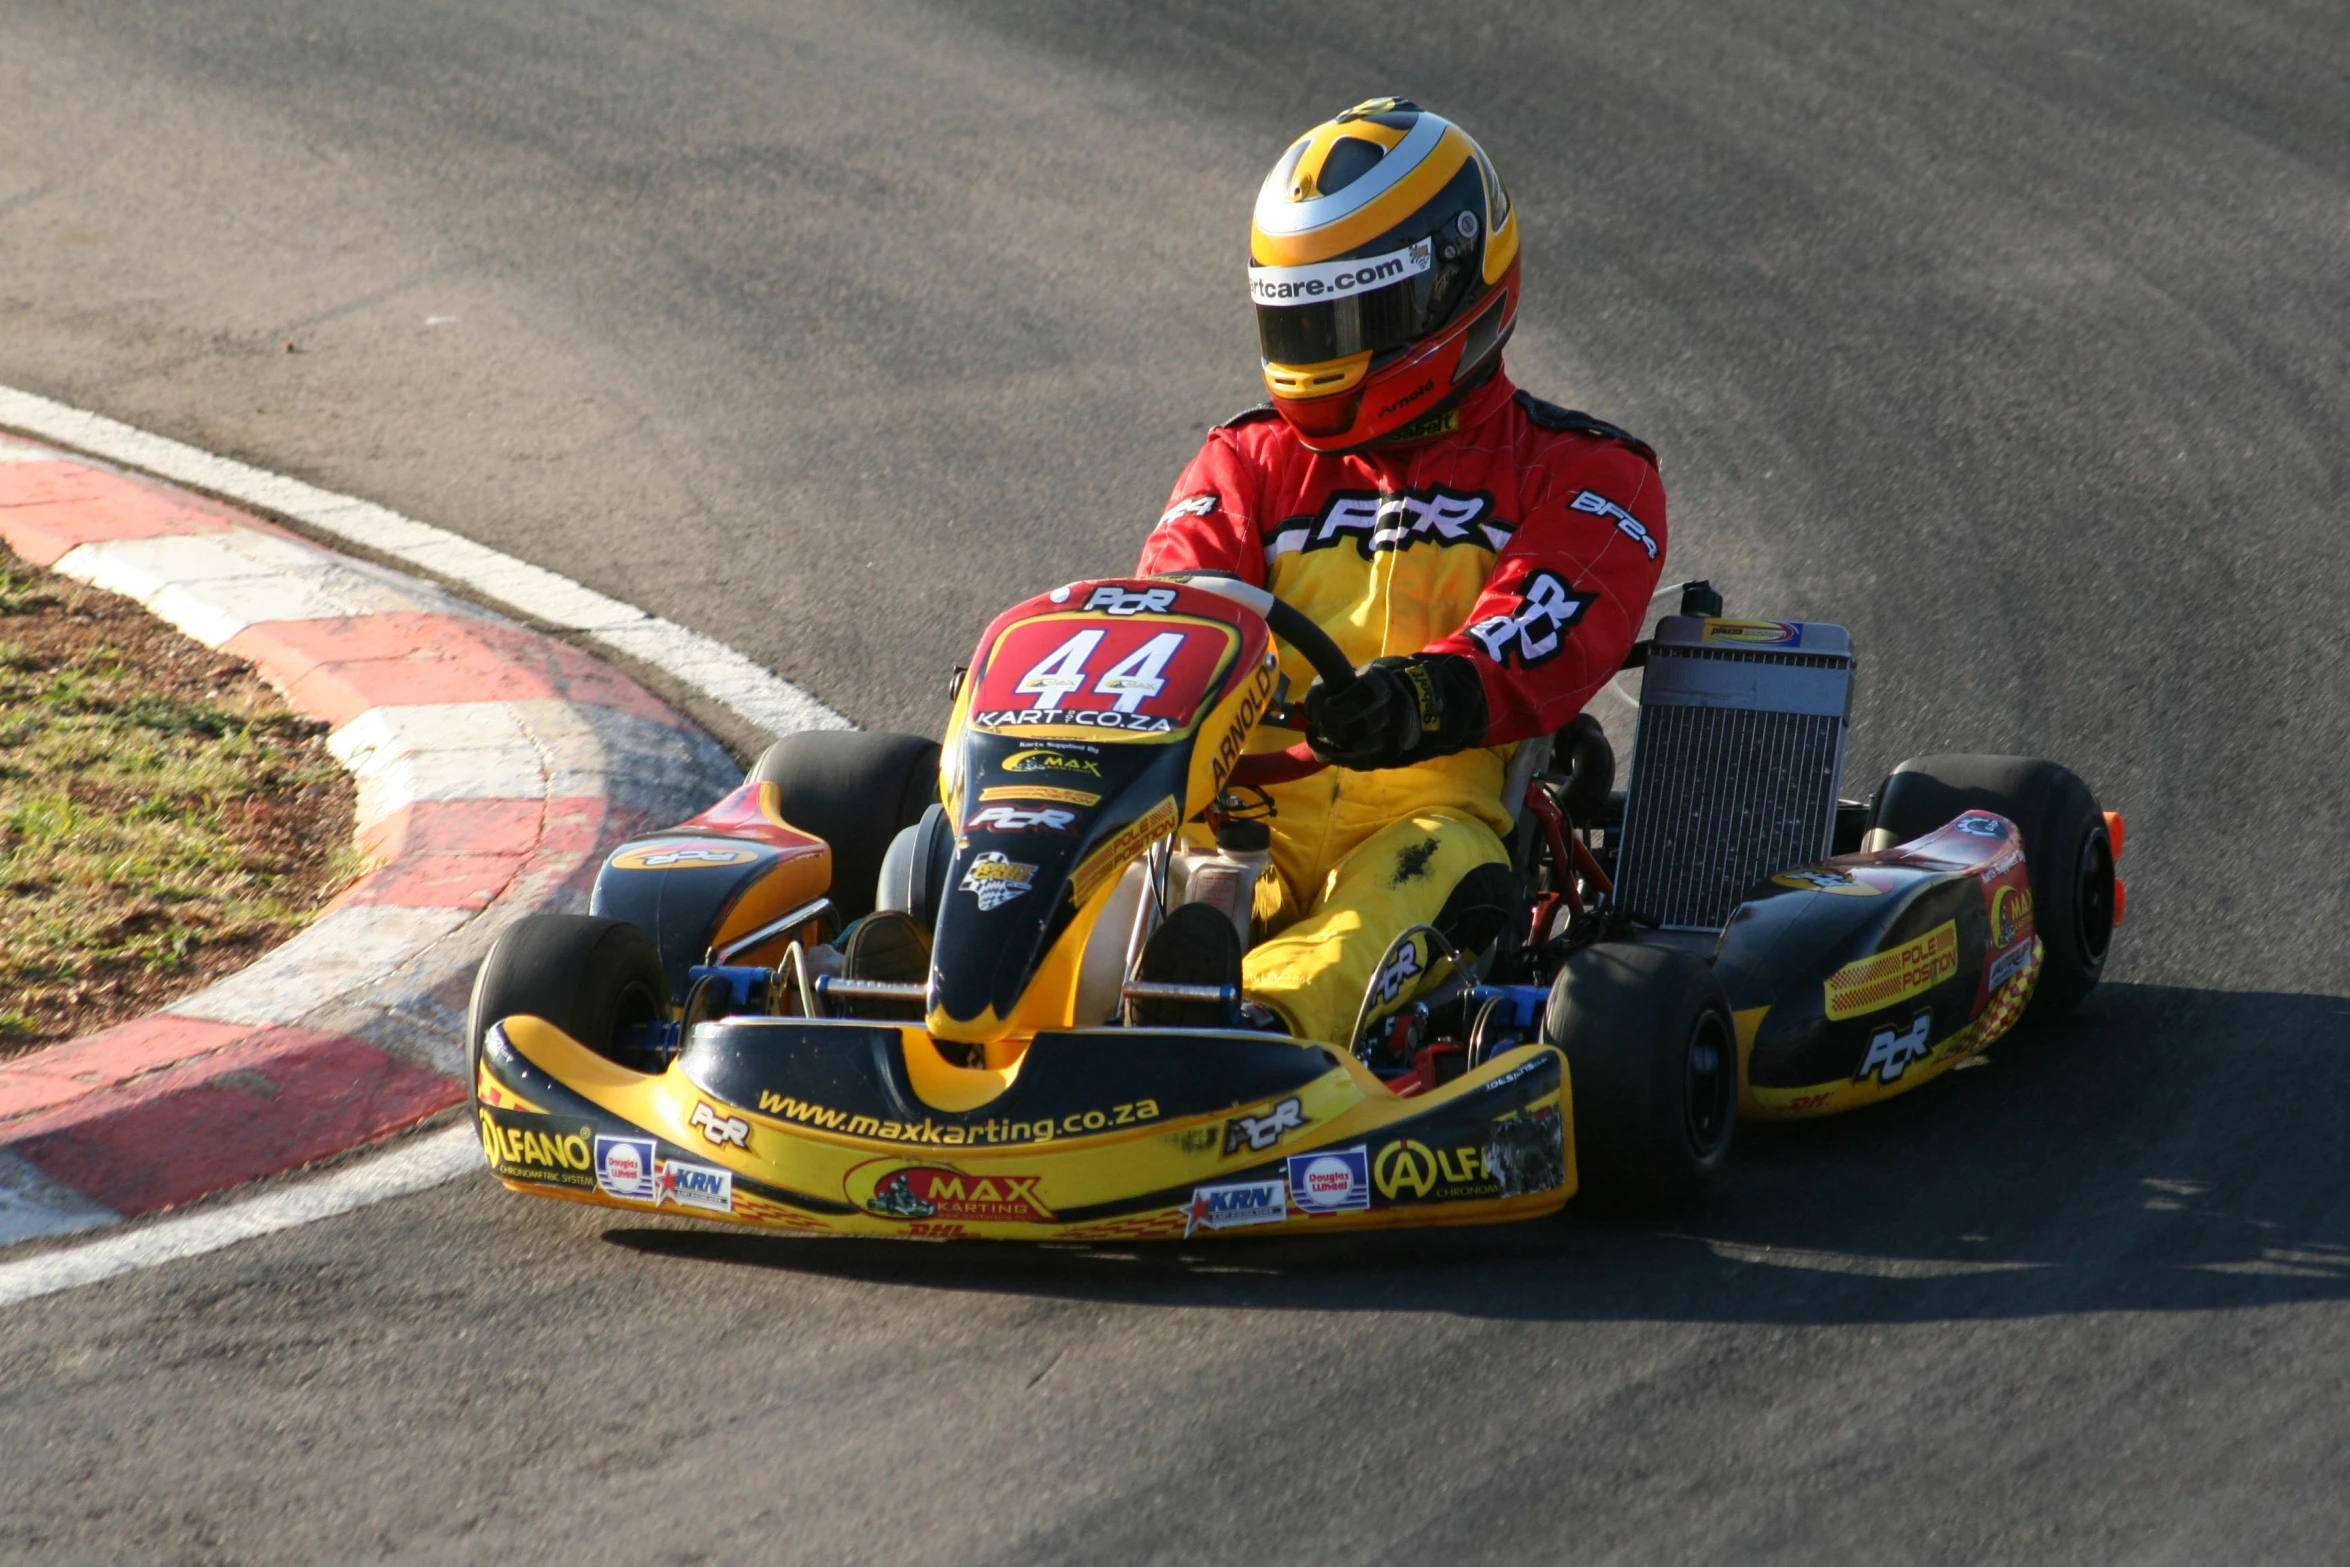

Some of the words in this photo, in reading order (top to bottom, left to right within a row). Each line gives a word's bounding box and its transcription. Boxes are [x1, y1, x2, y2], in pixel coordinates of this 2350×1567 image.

[1570, 490, 1659, 560] BF24
[1083, 586, 1177, 614] PCR
[1015, 629, 1184, 713] 44
[976, 709, 1062, 725] KART
[1075, 711, 1172, 732] CO.ZA
[1213, 665, 1270, 795] ARNOLD
[1044, 756, 1101, 777] MAX
[968, 806, 1076, 830] PCR
[1113, 818, 1149, 852] POLE
[1113, 816, 1176, 868] POSITION
[1903, 937, 1937, 969] POLE
[1903, 951, 1957, 992] POSITION
[1858, 1014, 1931, 1080] PCR
[691, 1102, 748, 1148] PCR
[758, 1089, 1160, 1144] www.maxkarting.co.za
[499, 1164, 561, 1182] CHRONOMETRIC
[562, 1174, 594, 1187] SYSTEM
[608, 1157, 638, 1169] Douglas
[611, 1168, 637, 1180] Wheel
[1309, 1171, 1349, 1183] Douglas
[675, 1168, 722, 1195] KRN
[1312, 1181, 1347, 1192] Wheel
[928, 1176, 1053, 1218] MAX
[937, 1201, 1028, 1214] KARTING
[1210, 1187, 1273, 1213] KRN
